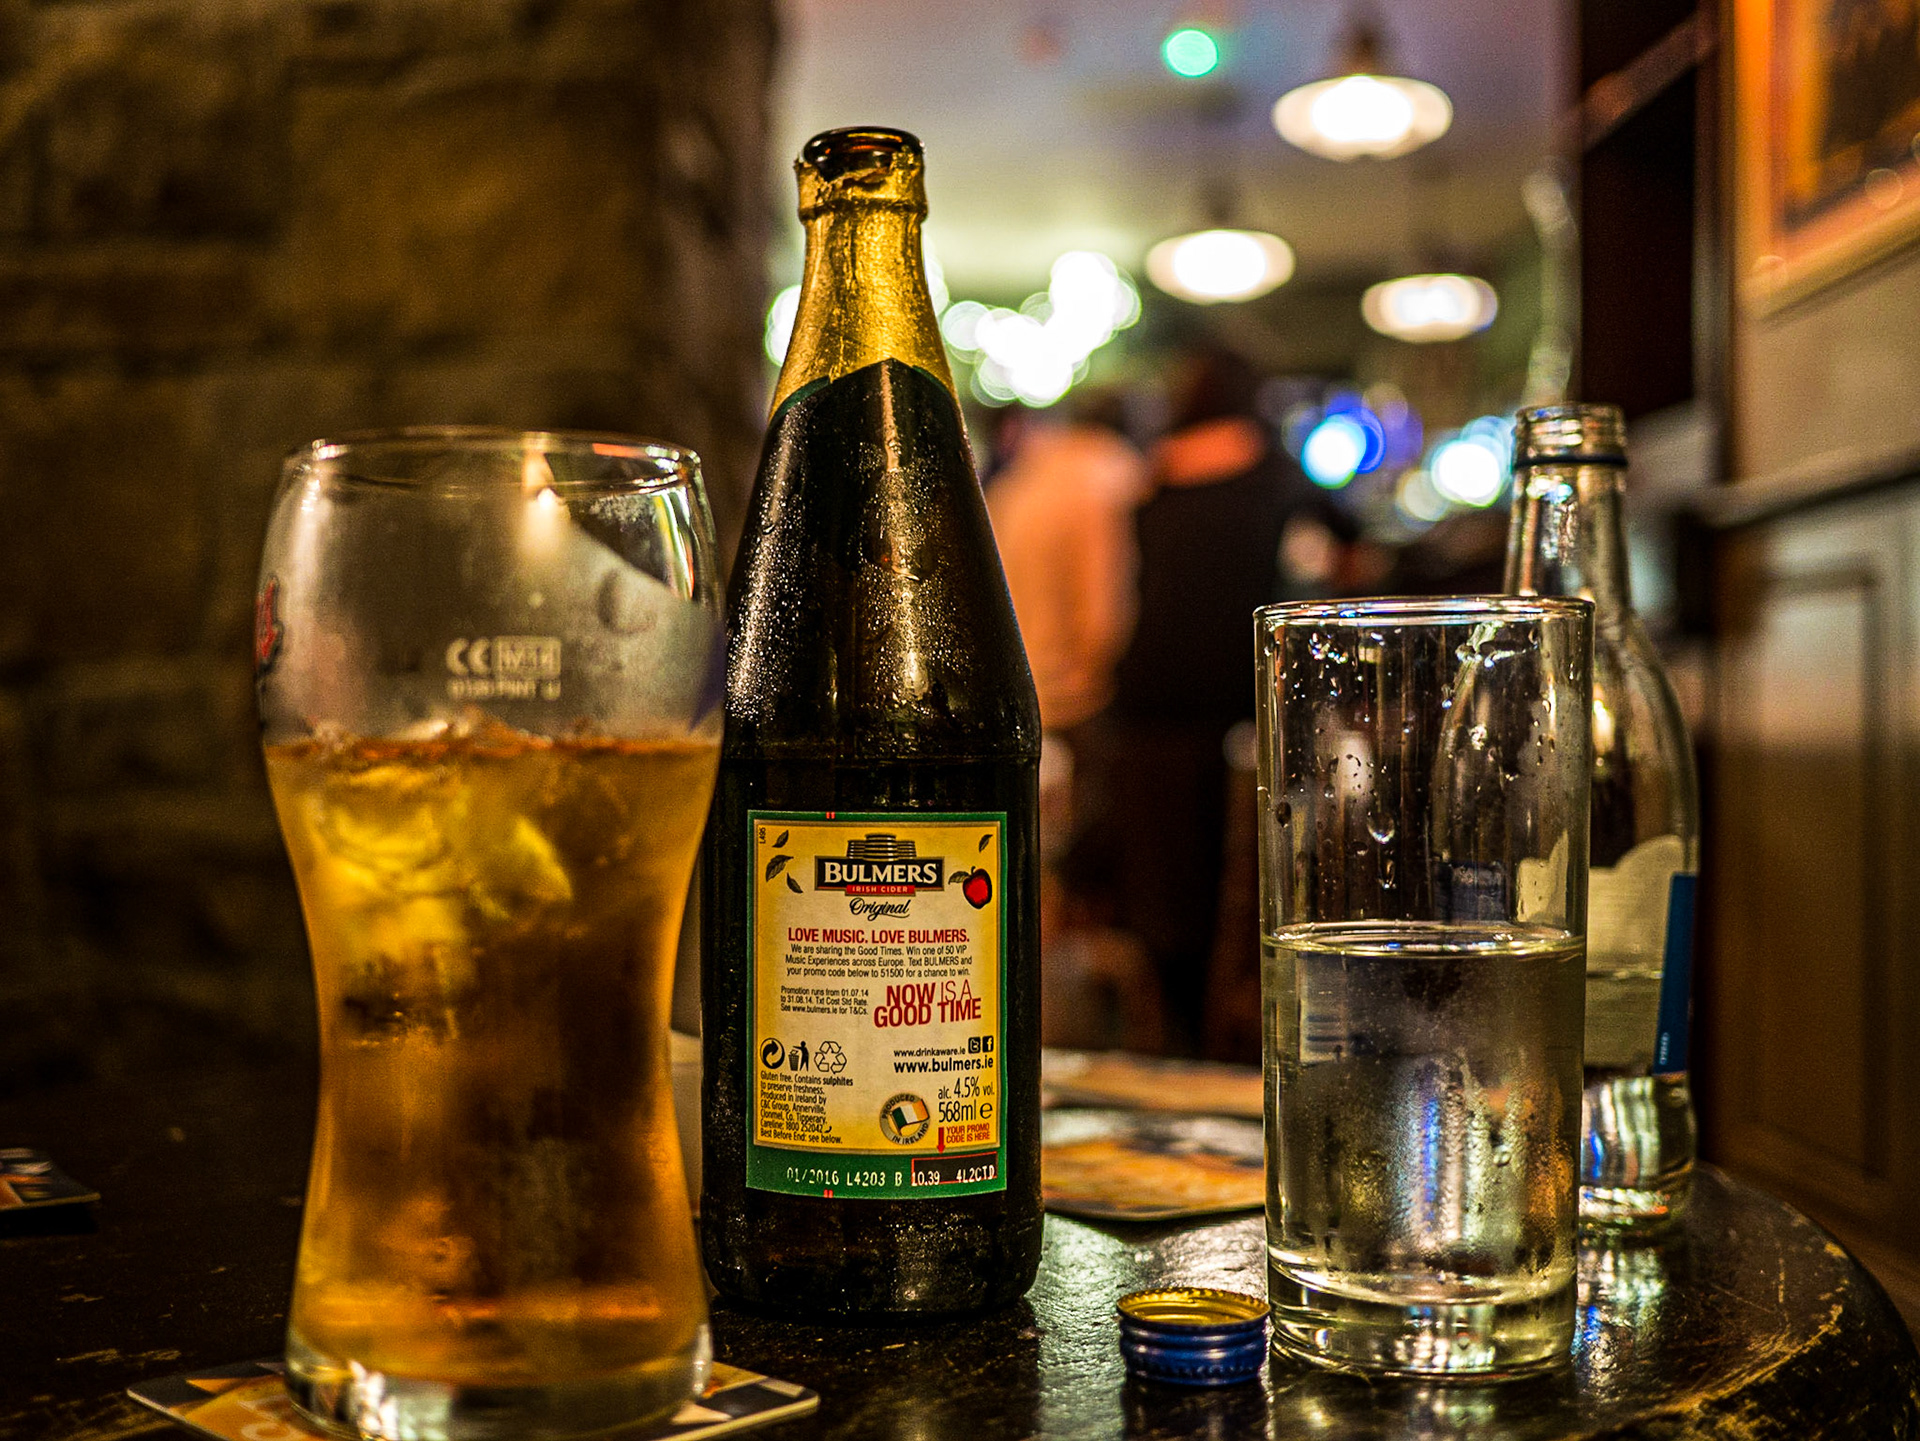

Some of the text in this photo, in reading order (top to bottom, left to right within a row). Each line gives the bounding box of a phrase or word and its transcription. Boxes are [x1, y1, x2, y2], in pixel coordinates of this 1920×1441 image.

[824, 861, 938, 884] BULMERS
[852, 885, 908, 893] IRISH CIDER
[849, 897, 911, 921] Original
[788, 927, 970, 944] LOVE MUSIC. LOVE BULMERS.
[791, 944, 967, 956] We are sharing the Good Times. Win one of 50 VIP
[785, 954, 806, 964] Music
[808, 955, 850, 966] Experiences
[908, 957, 922, 966] Text
[924, 956, 959, 966] BULMERS
[961, 956, 972, 965] and
[787, 967, 802, 976] your
[803, 968, 826, 977] promo
[828, 968, 845, 977] code
[847, 968, 869, 977] below
[871, 968, 879, 977] to
[880, 968, 904, 977] 51500
[906, 968, 916, 977] for
[923, 968, 948, 977] chance
[949, 967, 956, 976] to
[957, 966, 970, 975] win.
[781, 985, 810, 995] Promotion
[826, 988, 840, 996] from
[886, 978, 972, 1007] NOW IS A
[792, 1004, 837, 1014] www.bulmers.ie
[874, 997, 982, 1028] GOOD TIME
[894, 1046, 966, 1057] www.drinkaware.ie
[894, 1055, 994, 1073] www.bulmers.ie
[761, 1081, 825, 1094] to preserve freshness.
[795, 1074, 821, 1084] Contains
[823, 1076, 853, 1087] sulphites
[938, 1075, 995, 1099] alc. 4.5% vol.
[761, 1090, 827, 1106] Produced in Ireland by
[881, 1093, 916, 1119] PRODUCED
[939, 1099, 976, 1123] 568ml
[761, 1128, 772, 1137] Best
[774, 1130, 792, 1140] Before
[809, 1134, 819, 1142] see
[901, 1122, 929, 1145] IRELAND
[946, 1123, 990, 1134] YOUR PROMO
[946, 1131, 990, 1143] CODE IS HERE
[786, 1167, 839, 1186] 01/2016
[847, 1171, 886, 1187] L4203
[895, 1171, 903, 1187] B
